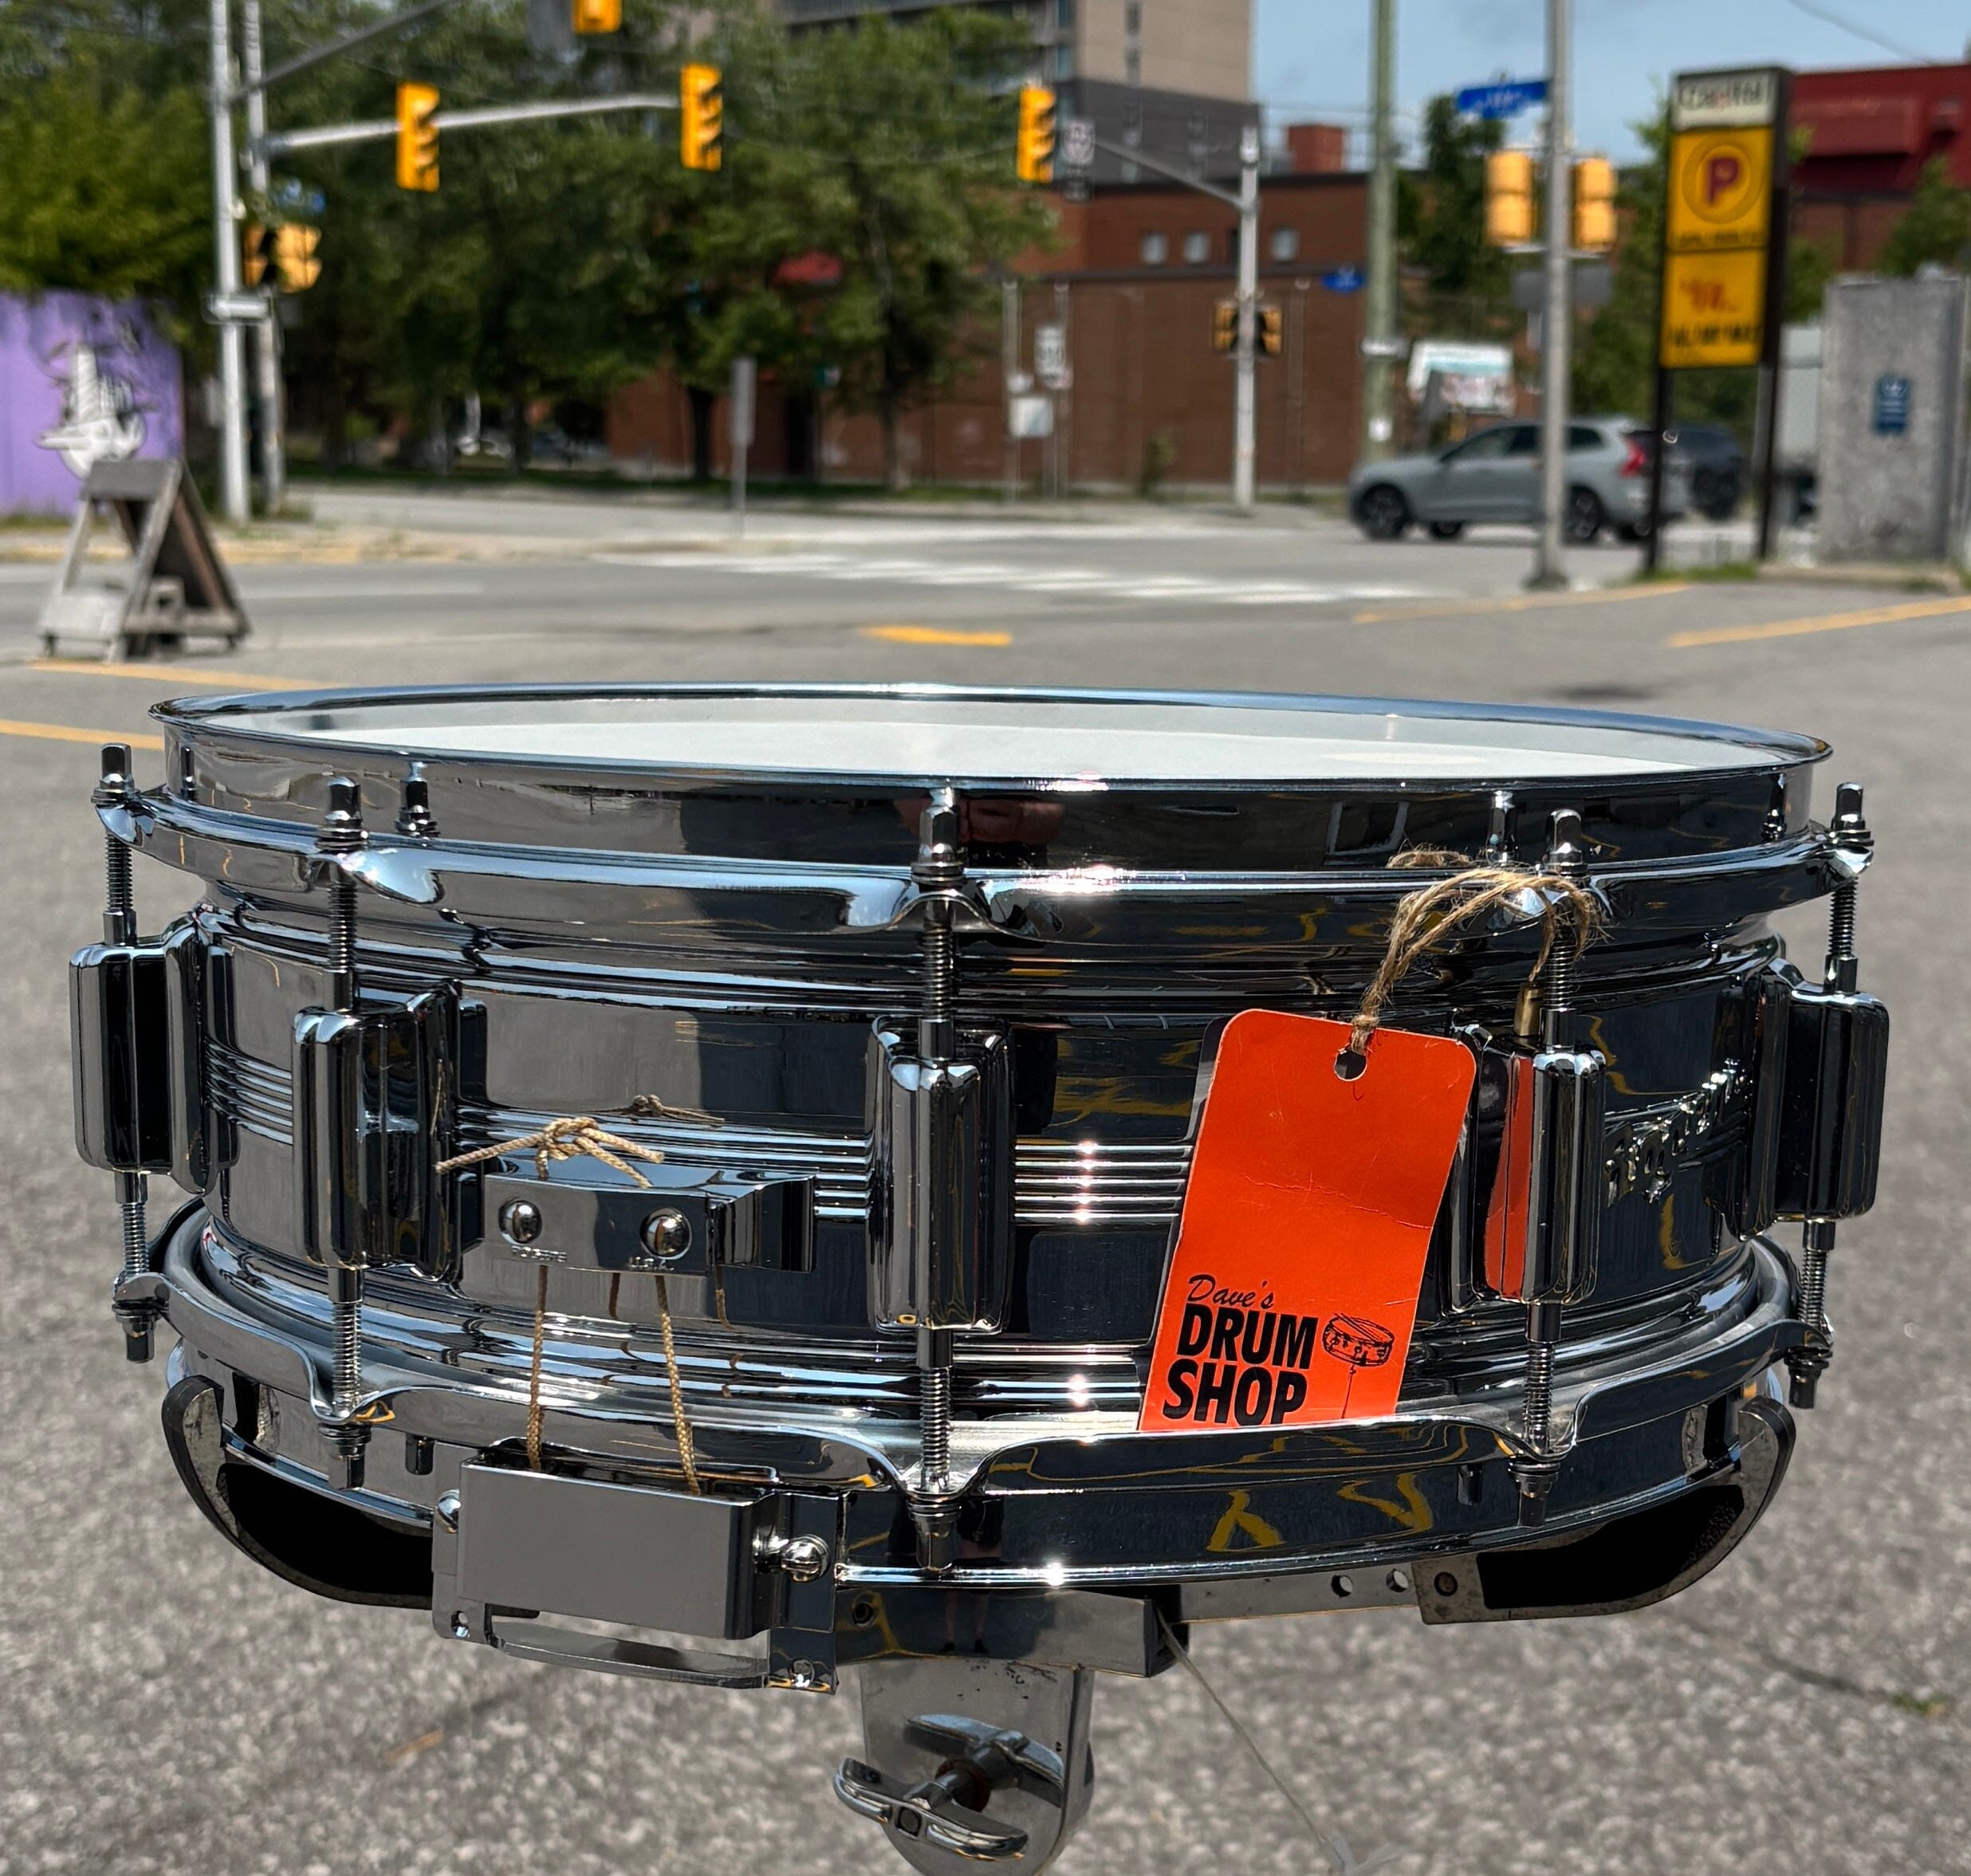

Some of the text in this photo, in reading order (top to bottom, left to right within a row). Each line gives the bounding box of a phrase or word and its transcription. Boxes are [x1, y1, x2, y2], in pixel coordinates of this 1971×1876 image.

[1705, 157, 1740, 204] P
[1188, 1274, 1274, 1309] Dave's
[1177, 1303, 1319, 1370] DRUM
[1163, 1359, 1308, 1426] SHOP
